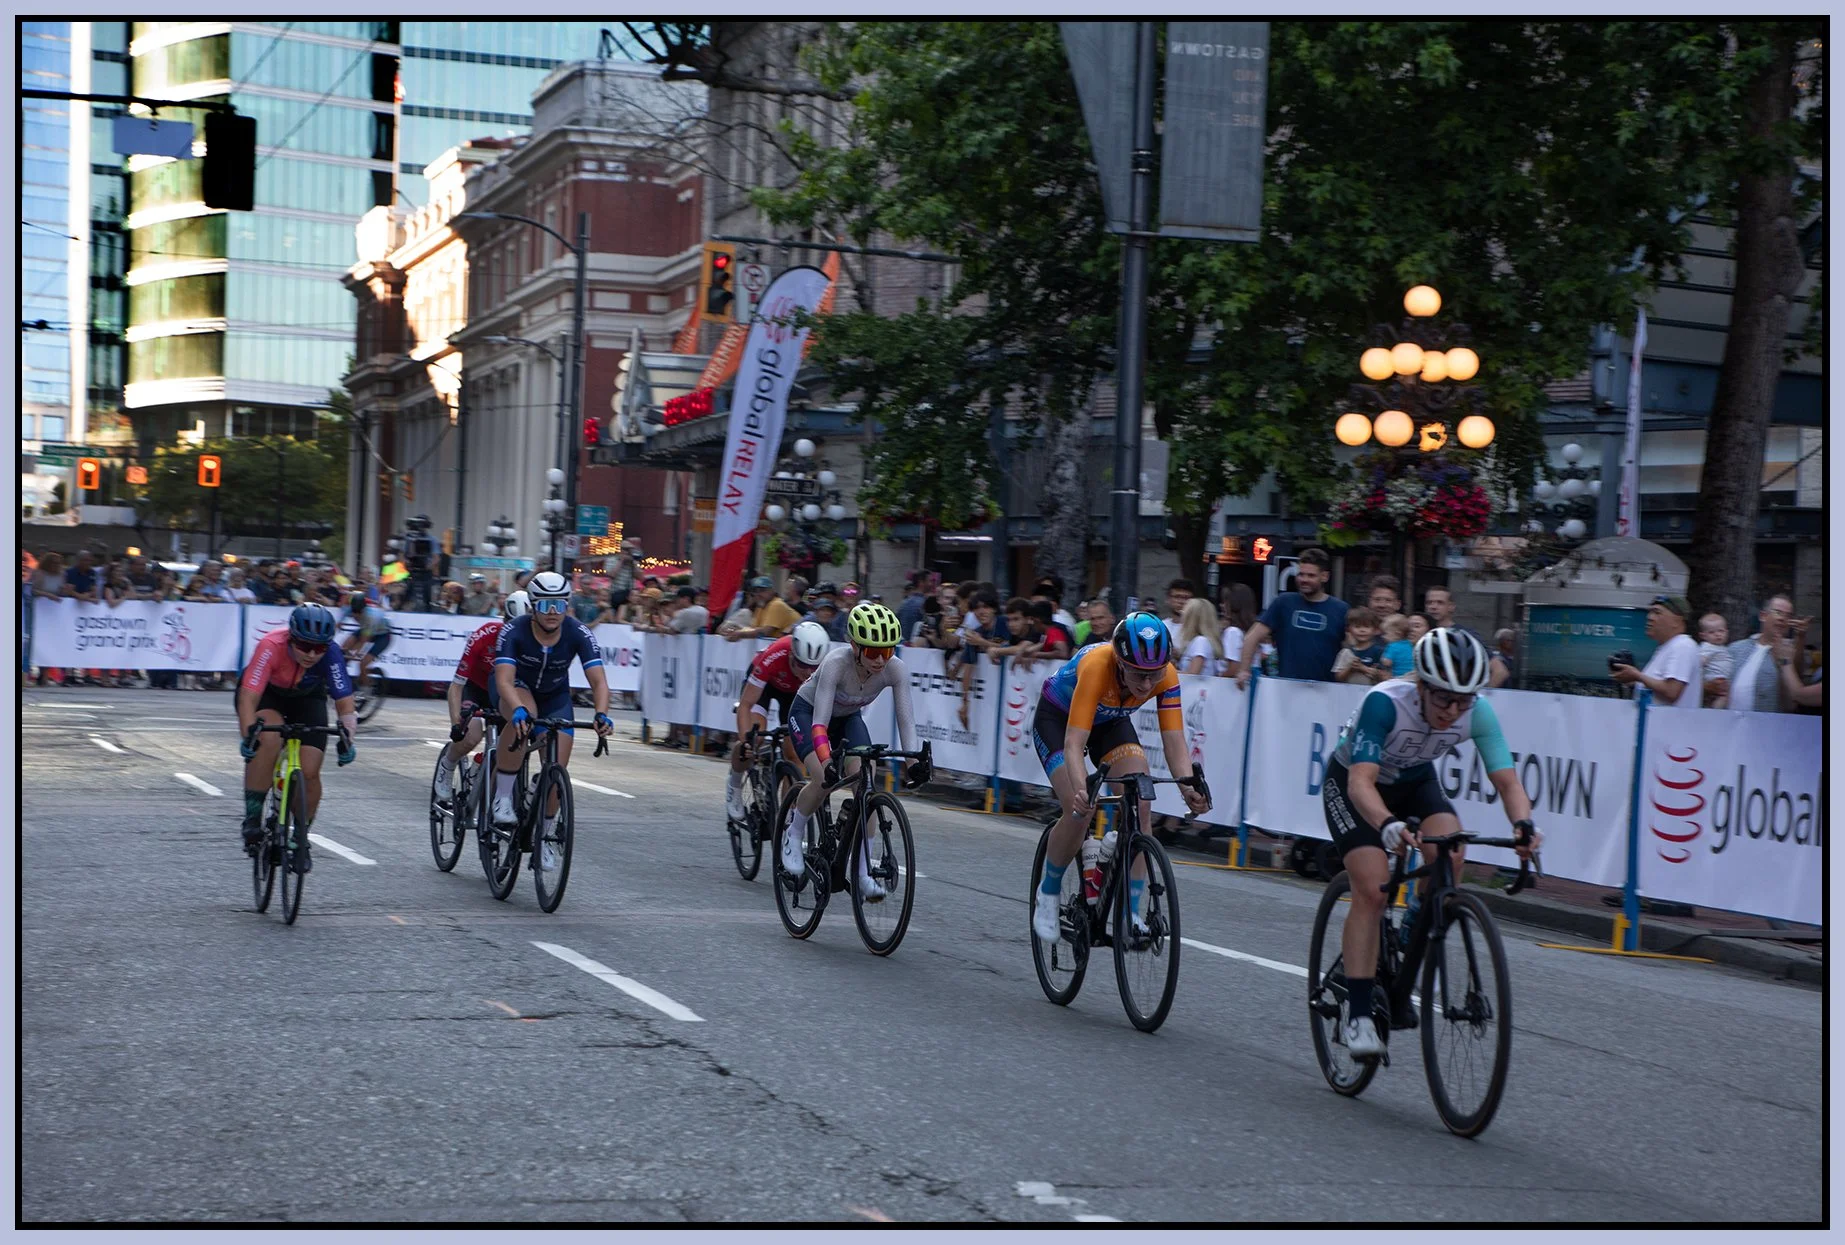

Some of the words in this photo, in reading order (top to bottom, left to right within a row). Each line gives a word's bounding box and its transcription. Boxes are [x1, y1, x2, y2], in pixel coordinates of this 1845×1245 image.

[742, 348, 784, 439] global
[723, 438, 757, 516] RELAY
[75, 615, 147, 633] gastown
[76, 631, 126, 651] grand
[129, 633, 157, 651] prix
[464, 626, 498, 656] MOSAIC
[1710, 764, 1822, 855] global
